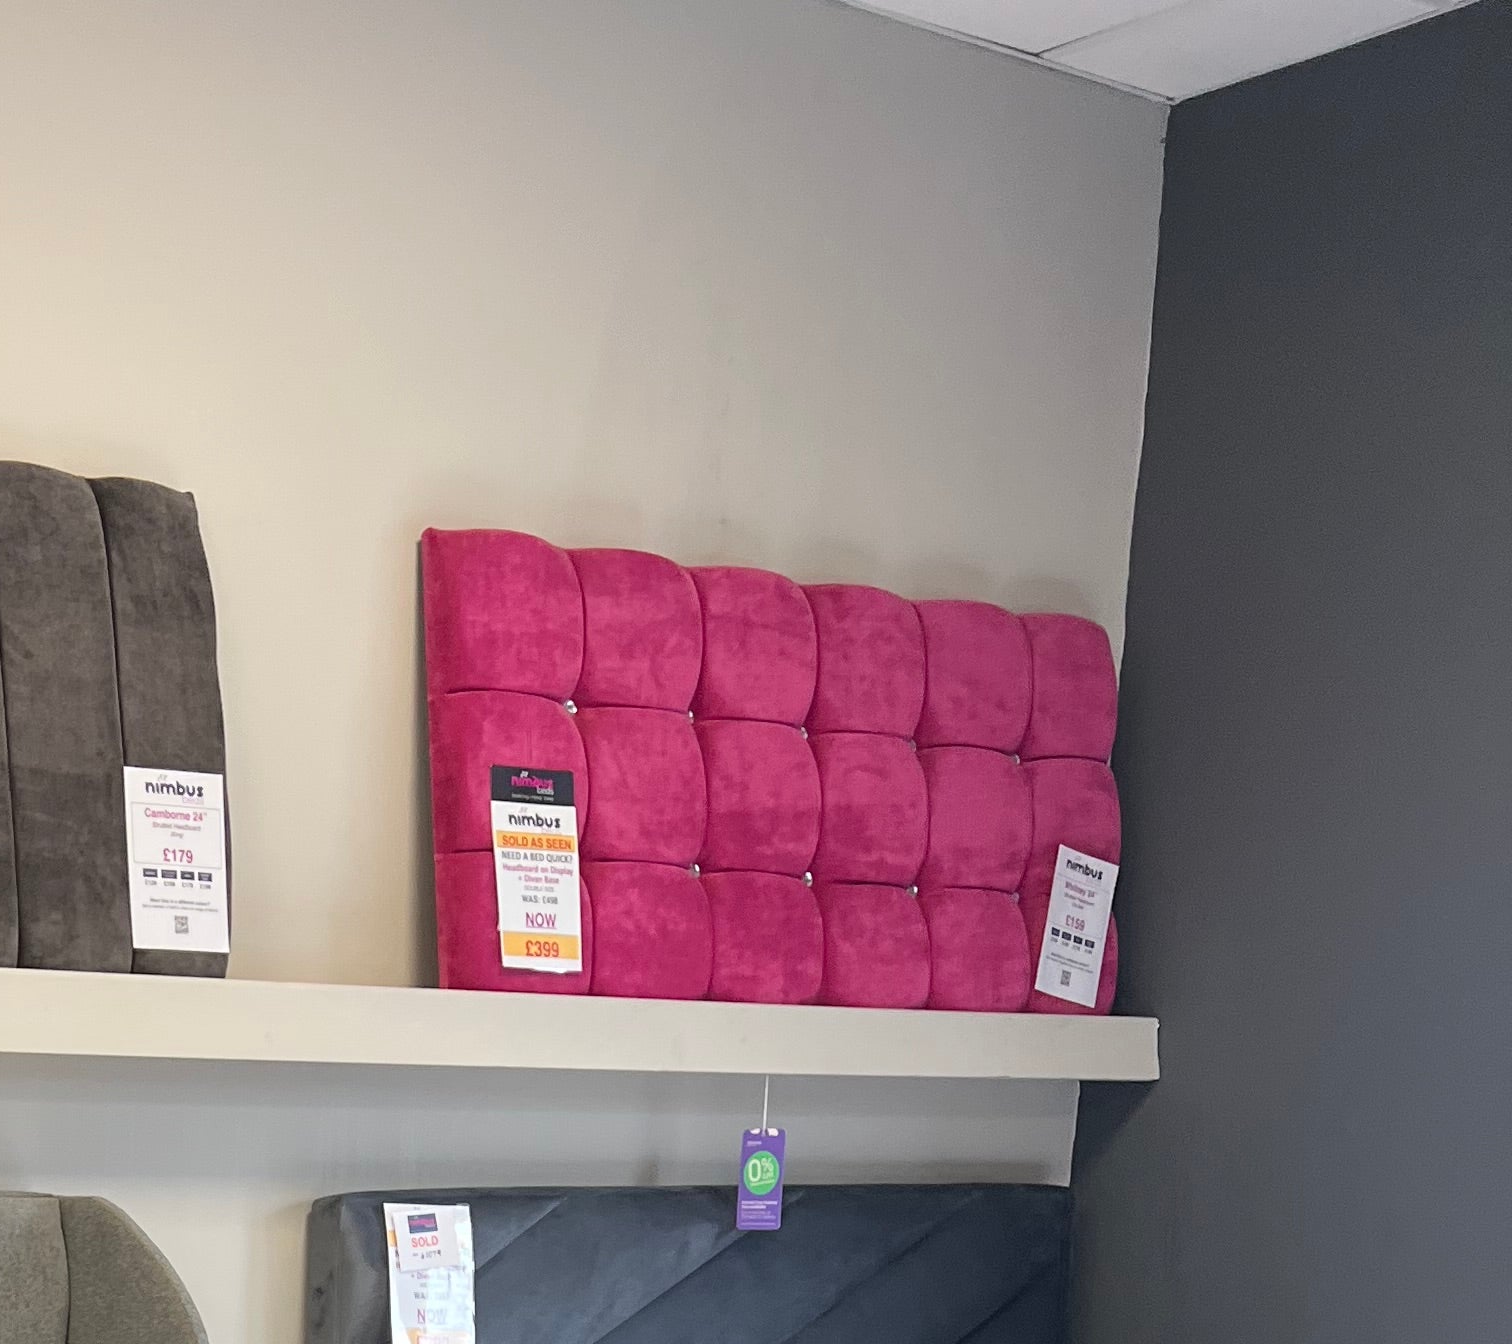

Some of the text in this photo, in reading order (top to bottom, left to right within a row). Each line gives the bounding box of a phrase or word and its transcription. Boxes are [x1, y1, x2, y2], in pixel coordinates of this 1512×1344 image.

[145, 780, 204, 798] nimbus
[508, 813, 561, 829] nimbus
[502, 834, 572, 850] SOLD AS SEEN
[163, 847, 193, 864] £179
[1065, 859, 1103, 881] nimbus
[525, 912, 557, 929] NOW
[525, 940, 560, 958] £399
[411, 1235, 439, 1248] SOLD
